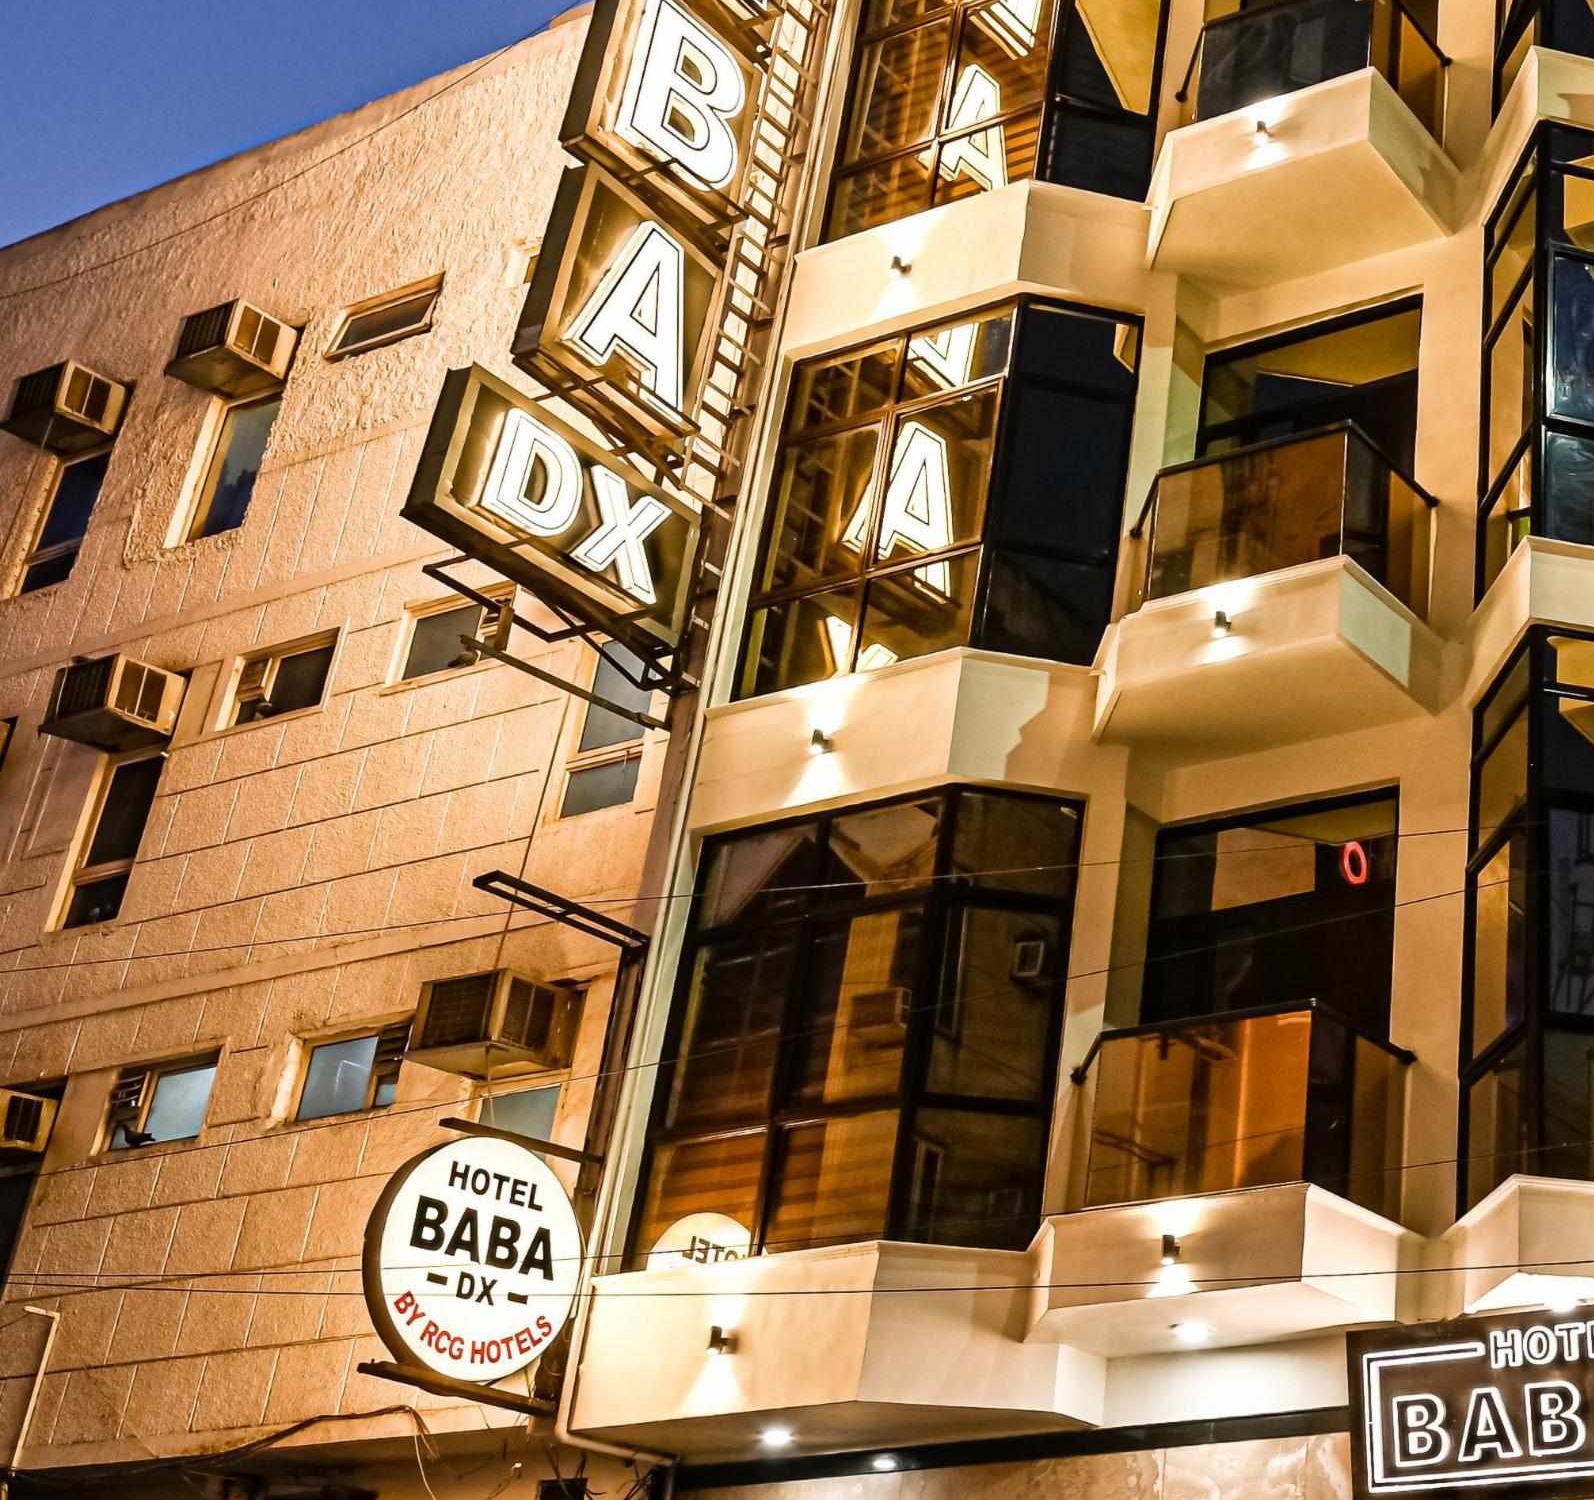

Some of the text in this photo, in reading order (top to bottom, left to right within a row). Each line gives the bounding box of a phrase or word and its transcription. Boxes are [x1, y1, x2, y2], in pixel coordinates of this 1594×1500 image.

[479, 406, 672, 605] DX
[449, 1160, 543, 1212] HOTEL
[409, 1195, 555, 1282] BABA
[393, 1290, 554, 1365] BY RCG HOTELS
